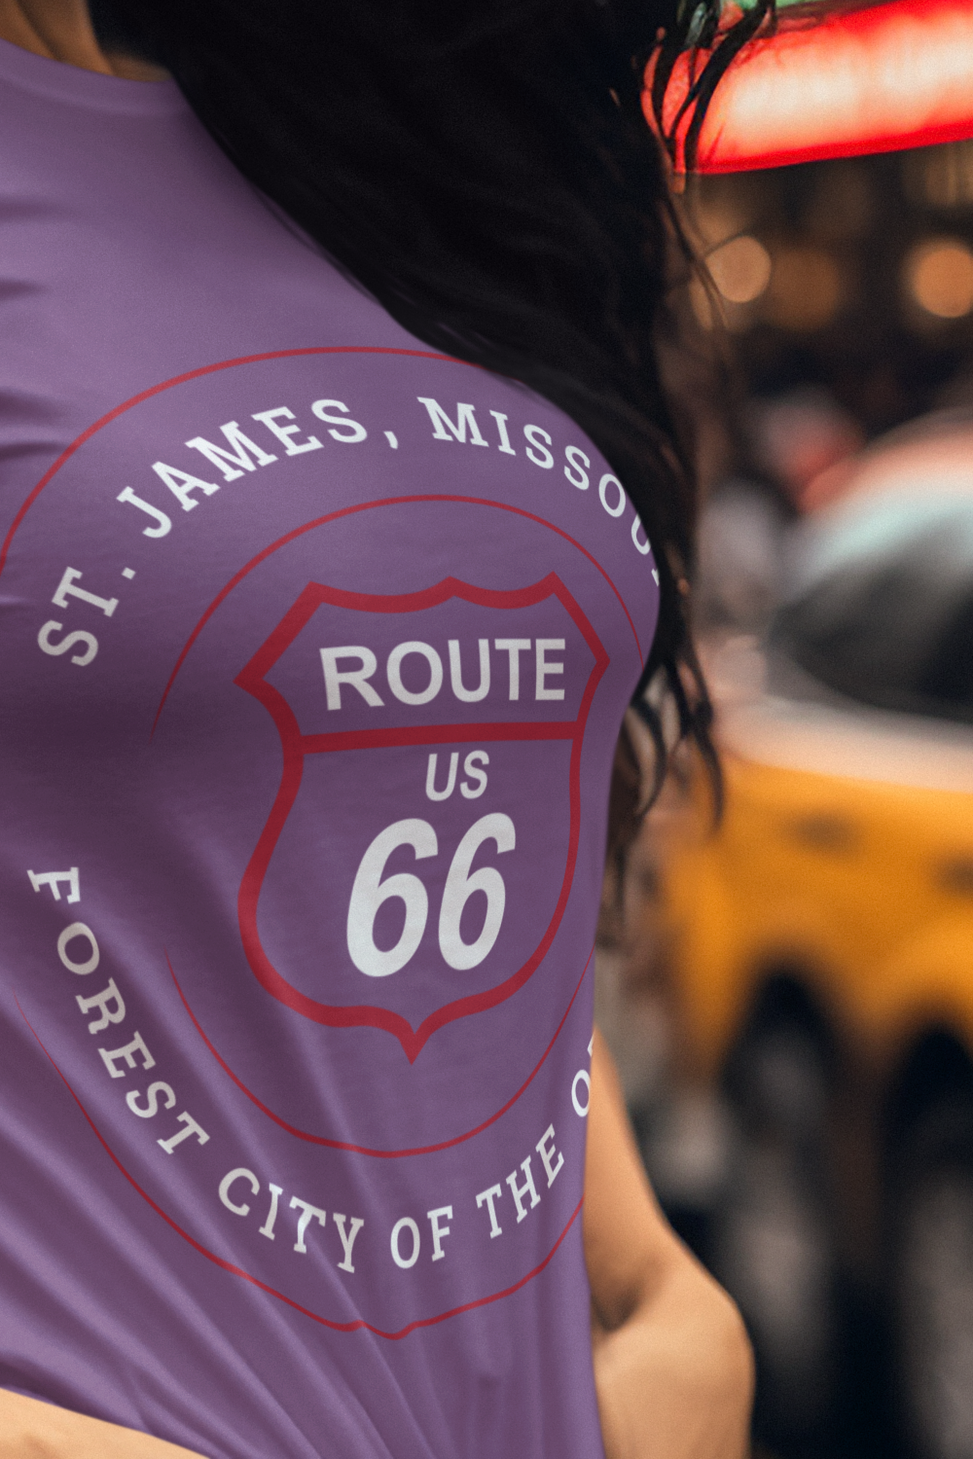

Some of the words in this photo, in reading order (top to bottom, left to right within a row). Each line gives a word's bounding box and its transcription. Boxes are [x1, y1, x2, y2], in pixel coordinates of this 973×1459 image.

[36, 565, 137, 667] ST.
[115, 396, 400, 539] JAMES,
[416, 395, 660, 587] MISSOU
[319, 638, 566, 711] ROUTE
[425, 749, 490, 802] US
[346, 812, 517, 978] 66
[26, 866, 211, 1155] FOREST
[217, 1167, 365, 1274] CITY
[389, 1204, 454, 1270] OF
[475, 1122, 566, 1240] THE
[570, 1034, 593, 1118] O
